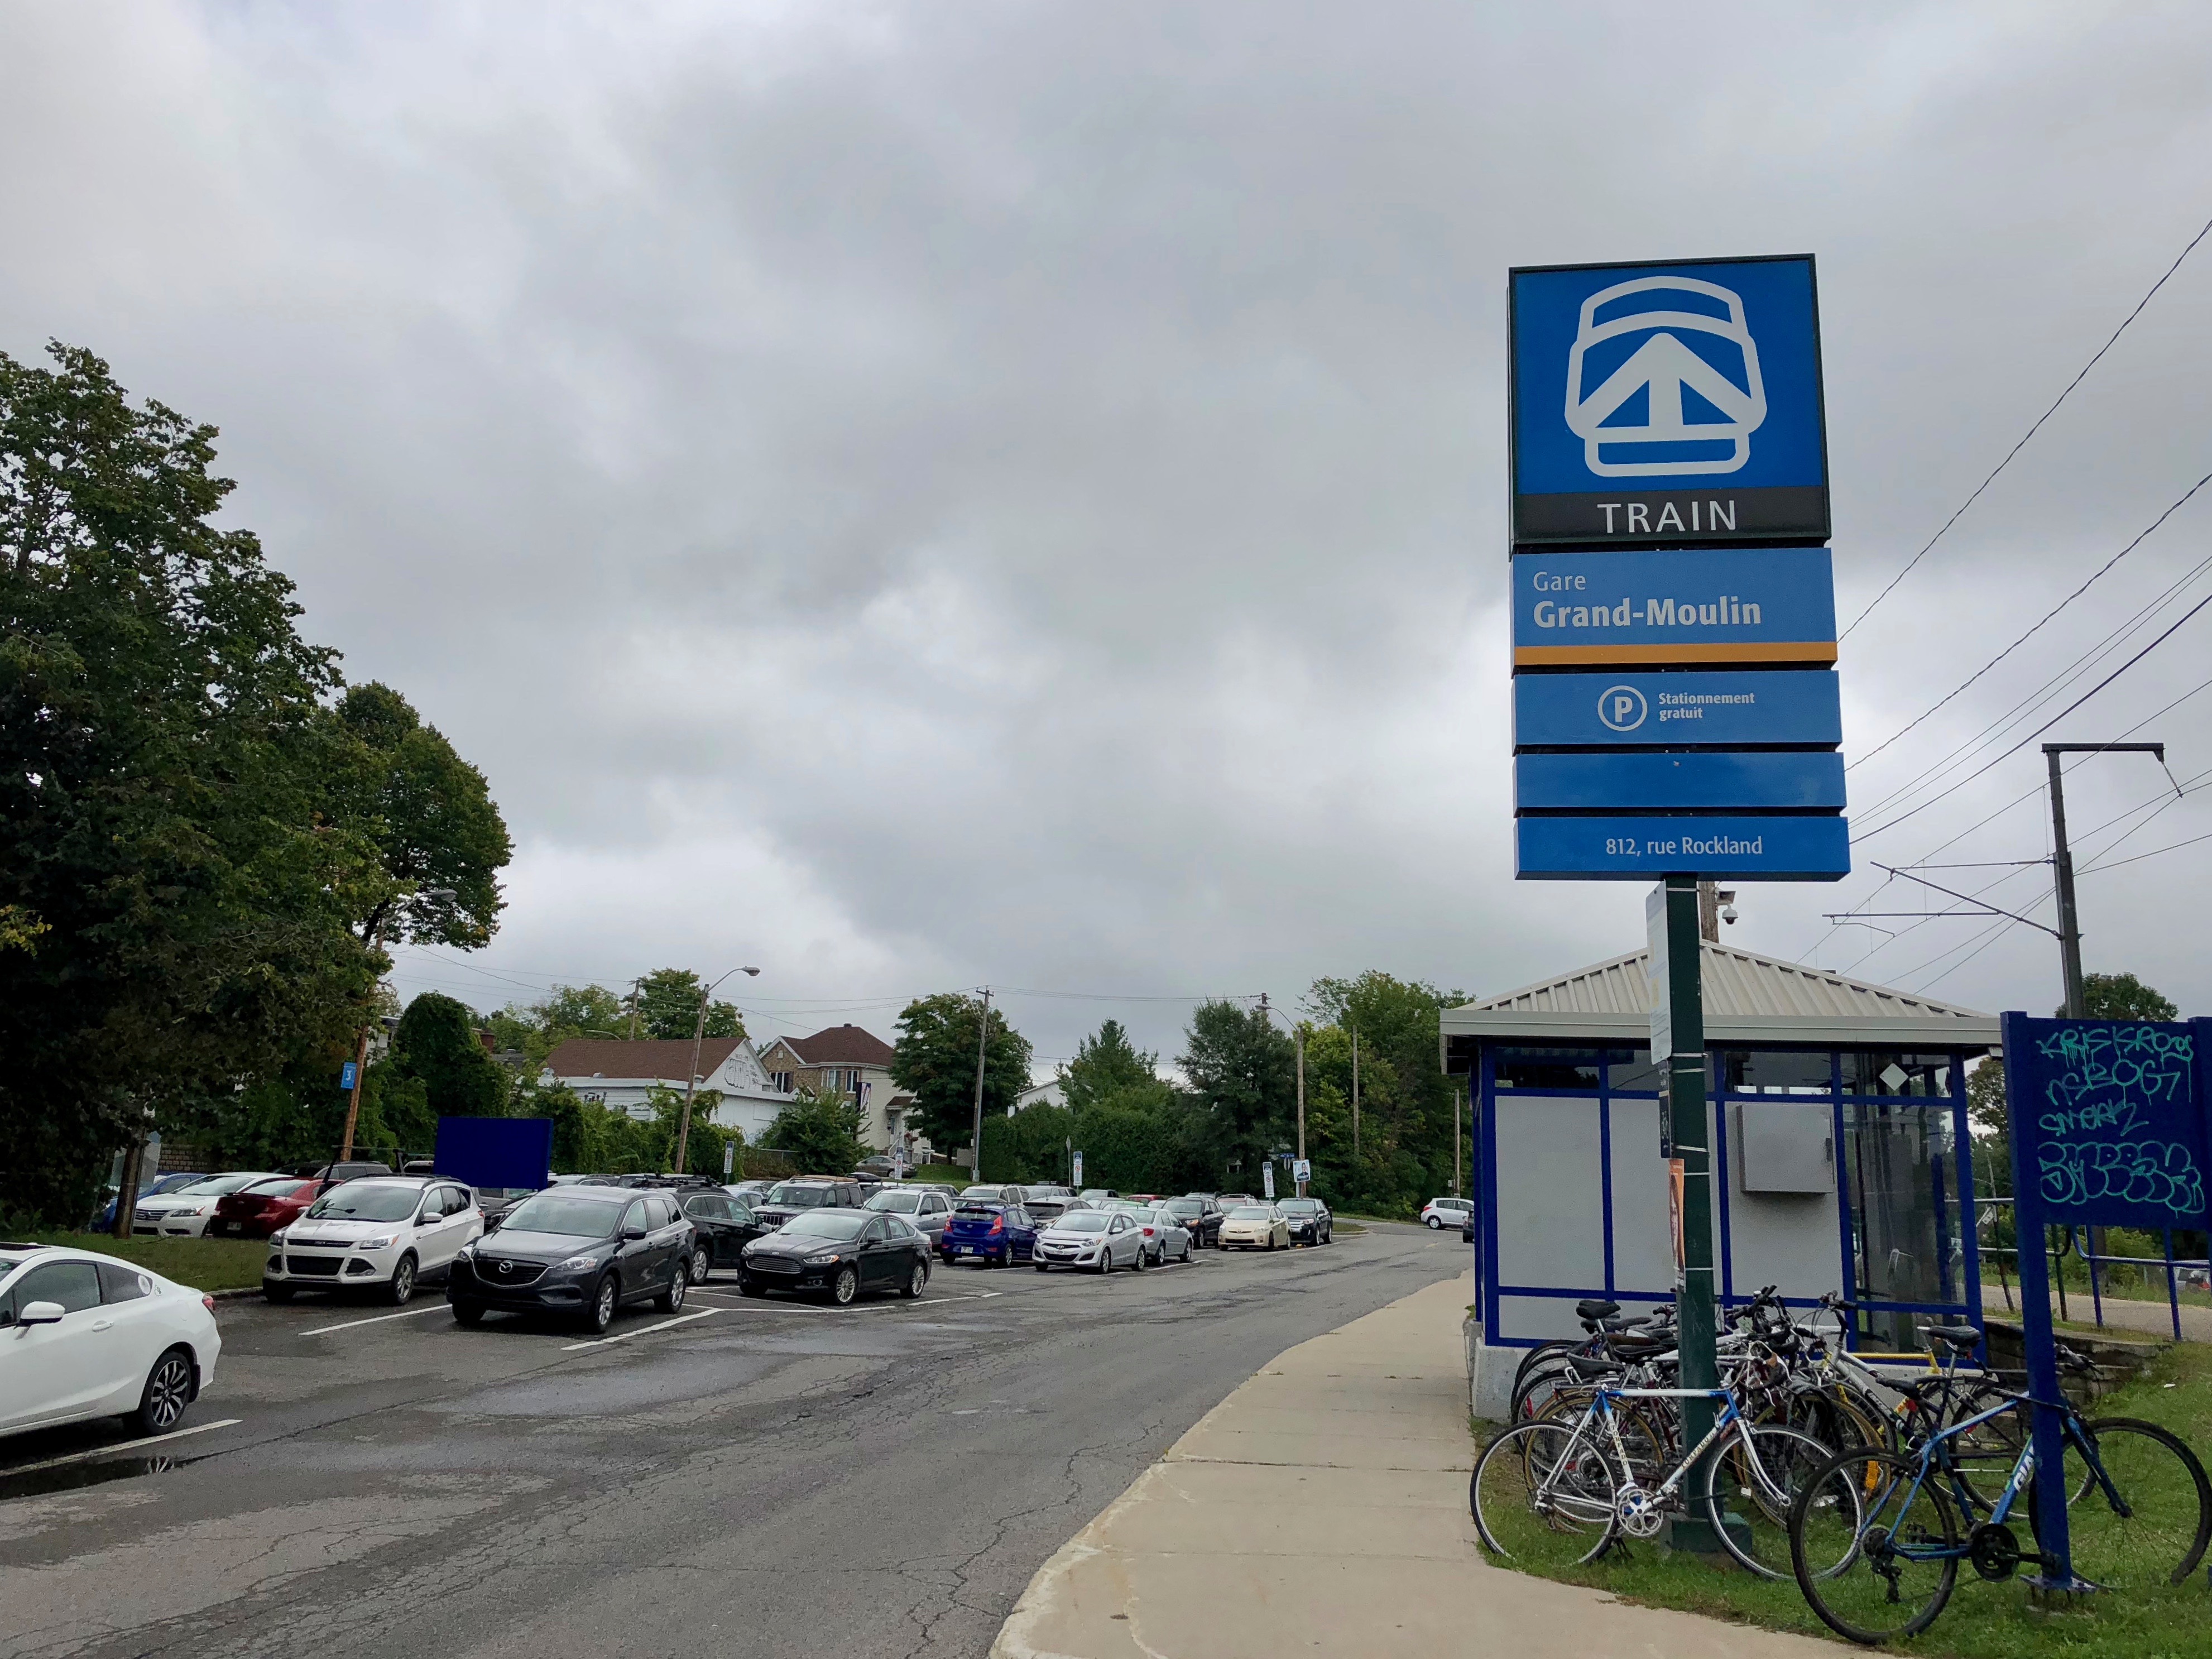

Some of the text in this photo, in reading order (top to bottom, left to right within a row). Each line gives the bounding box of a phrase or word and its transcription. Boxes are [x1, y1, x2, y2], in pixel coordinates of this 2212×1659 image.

[1596, 500, 1736, 534] TRAIN
[1533, 570, 1586, 591] Gare
[1533, 596, 1762, 628] Grand-Moulin
[1658, 692, 1755, 704] Stationnement
[1614, 696, 1633, 722] P
[1659, 706, 1703, 722] gratuit
[1605, 836, 1763, 857] 812, rue Rockland
[346, 1070, 352, 1081] 3
[2013, 1442, 2035, 1493] GIA
